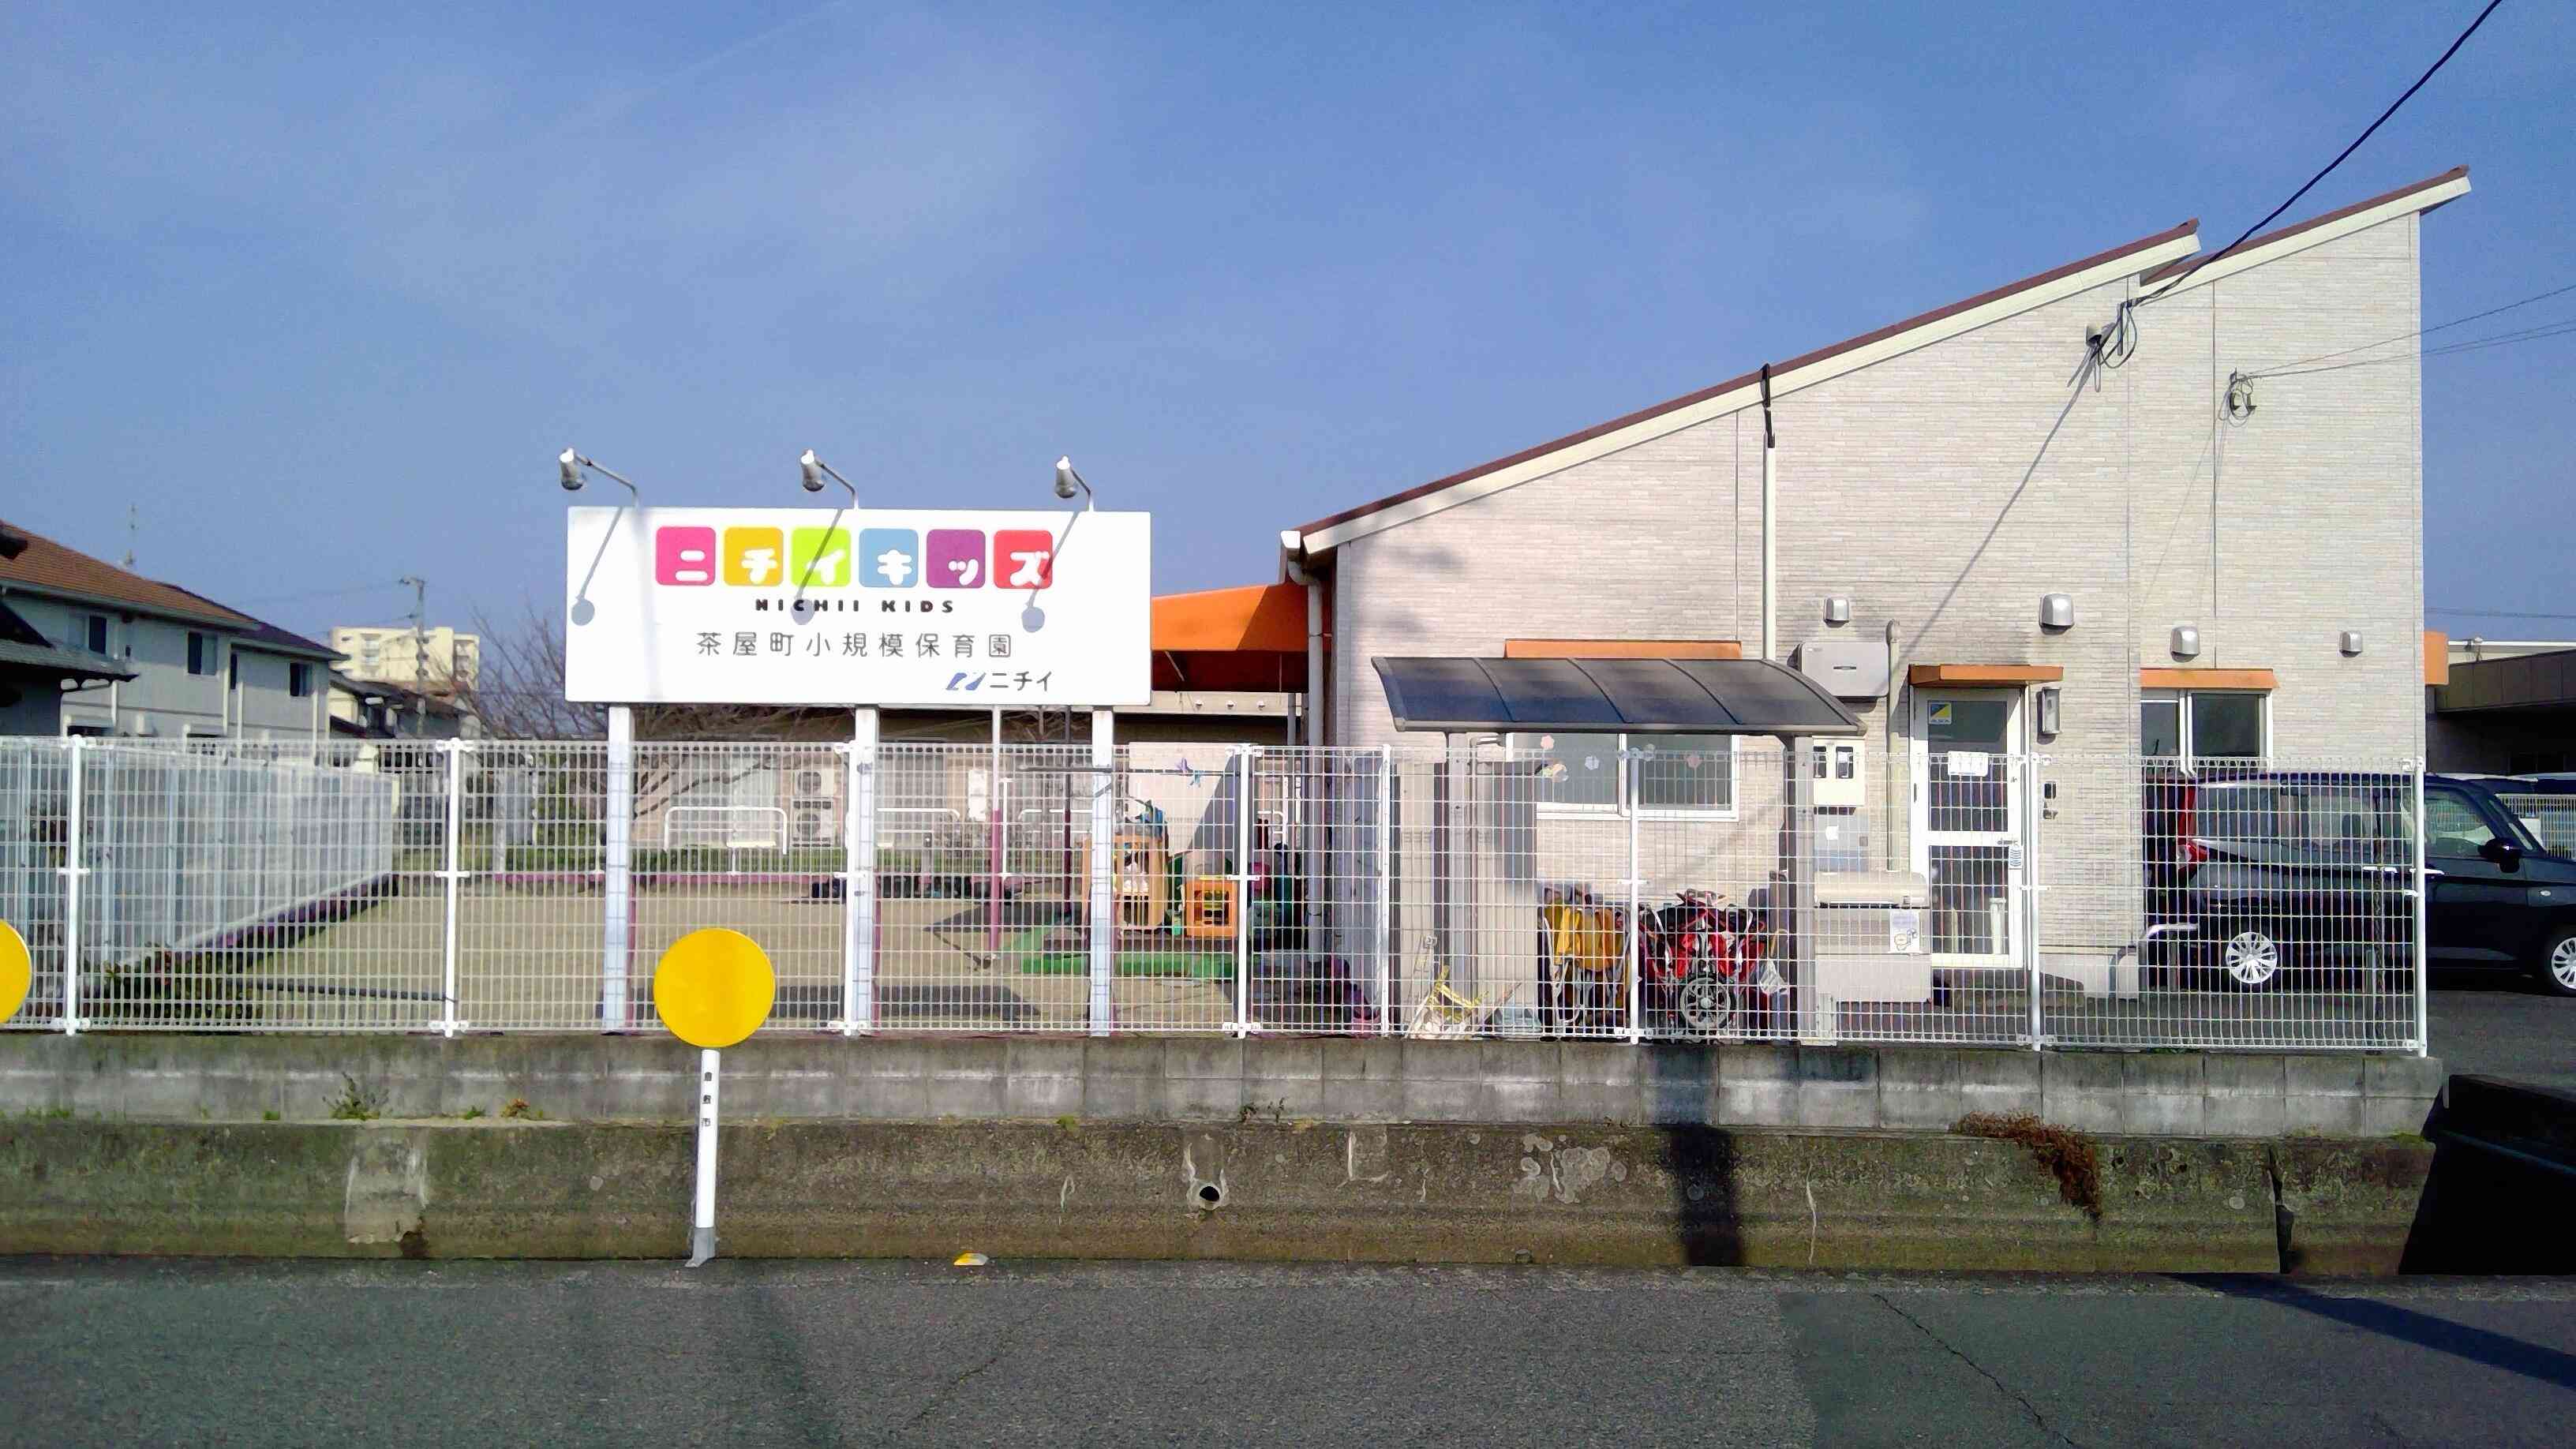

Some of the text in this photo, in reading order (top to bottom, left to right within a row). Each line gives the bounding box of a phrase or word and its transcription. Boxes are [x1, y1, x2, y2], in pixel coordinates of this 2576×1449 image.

[675, 548, 1050, 586] ニチイキッズ
[756, 599, 953, 613] NICHII KIDS
[697, 631, 1011, 657] 茶屋町小規模保育園
[990, 671, 1052, 691] ニチイ
